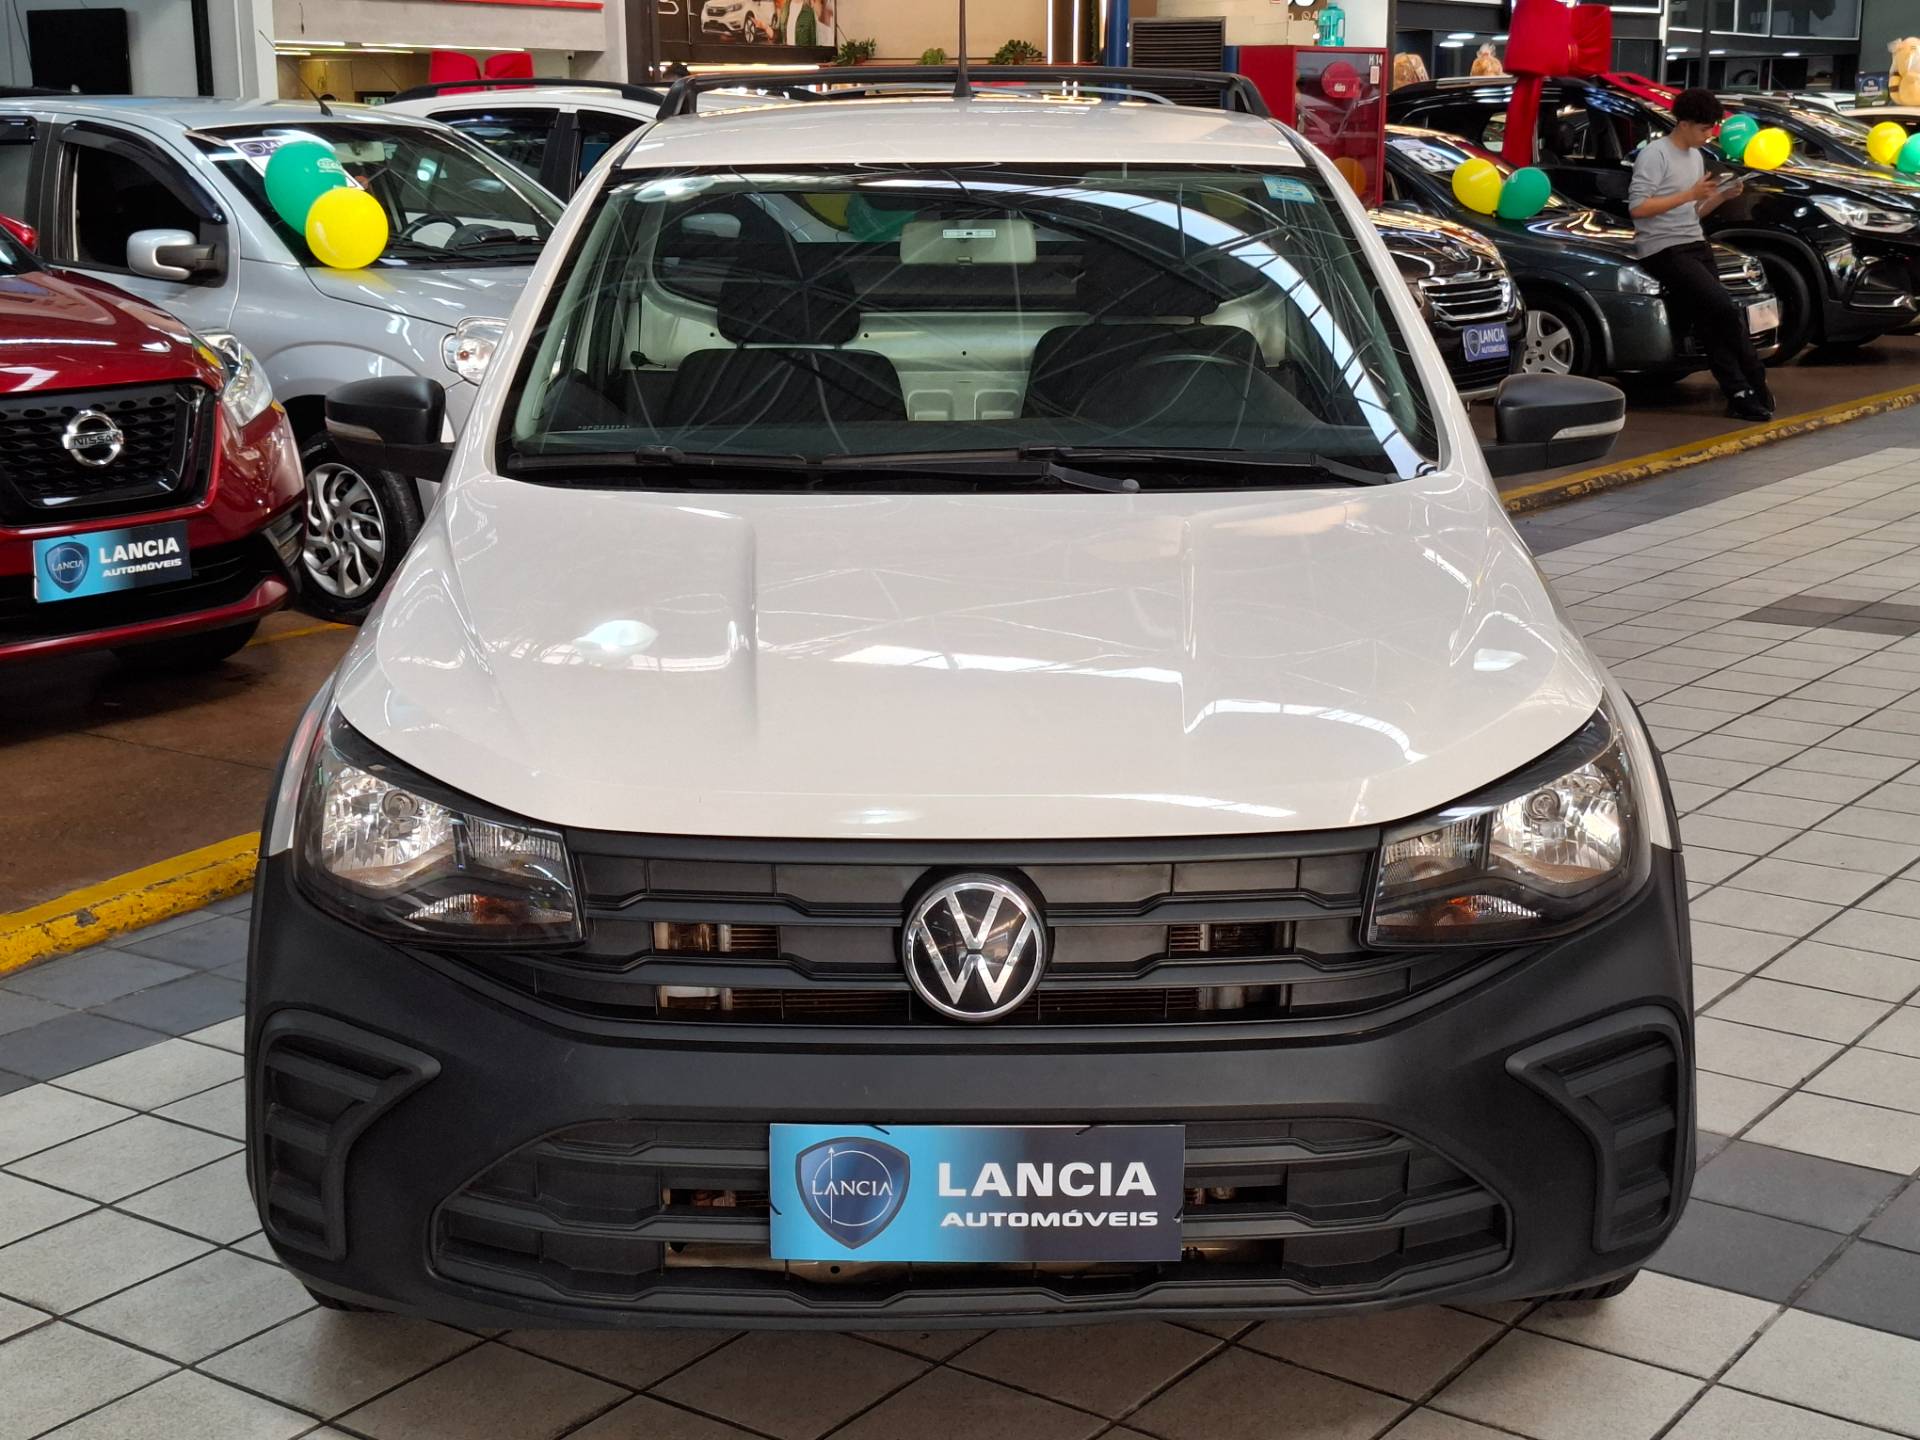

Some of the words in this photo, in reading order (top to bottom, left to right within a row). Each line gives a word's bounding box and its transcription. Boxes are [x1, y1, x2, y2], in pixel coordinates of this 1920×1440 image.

[1480, 327, 1506, 344] LANCIA
[73, 433, 121, 447] NISSAN
[100, 537, 180, 564] LANCIA
[52, 559, 84, 572] LANCIA
[103, 558, 182, 577] AUTOMÓVEIS
[811, 1179, 893, 1196] LANCIA
[938, 1161, 1158, 1197] LANCIA
[940, 1209, 1159, 1227] AUTOMÓVEIS
